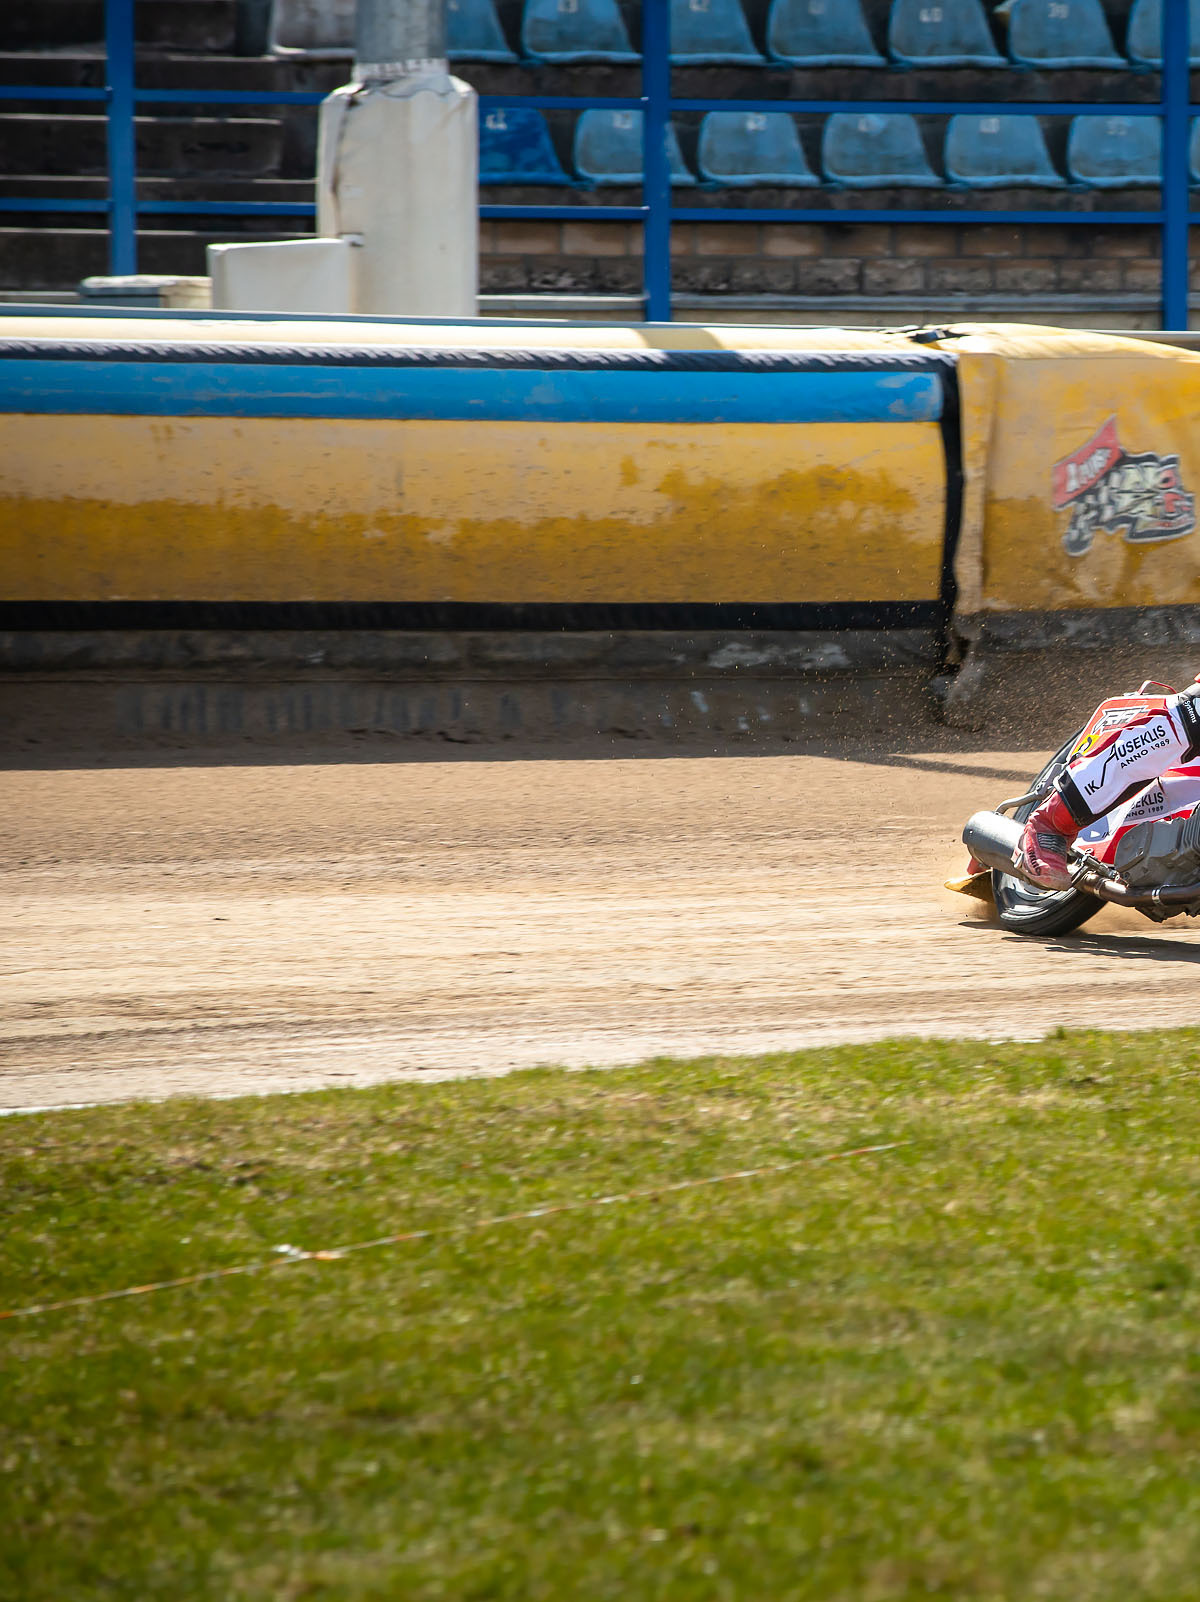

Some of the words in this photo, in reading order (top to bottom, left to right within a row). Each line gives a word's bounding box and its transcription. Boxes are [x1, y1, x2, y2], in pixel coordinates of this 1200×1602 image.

[1184, 700, 1197, 724] Systems
[1120, 748, 1149, 769] ANNO
[1150, 738, 1170, 751] 1989
[1084, 780, 1101, 796] IK
